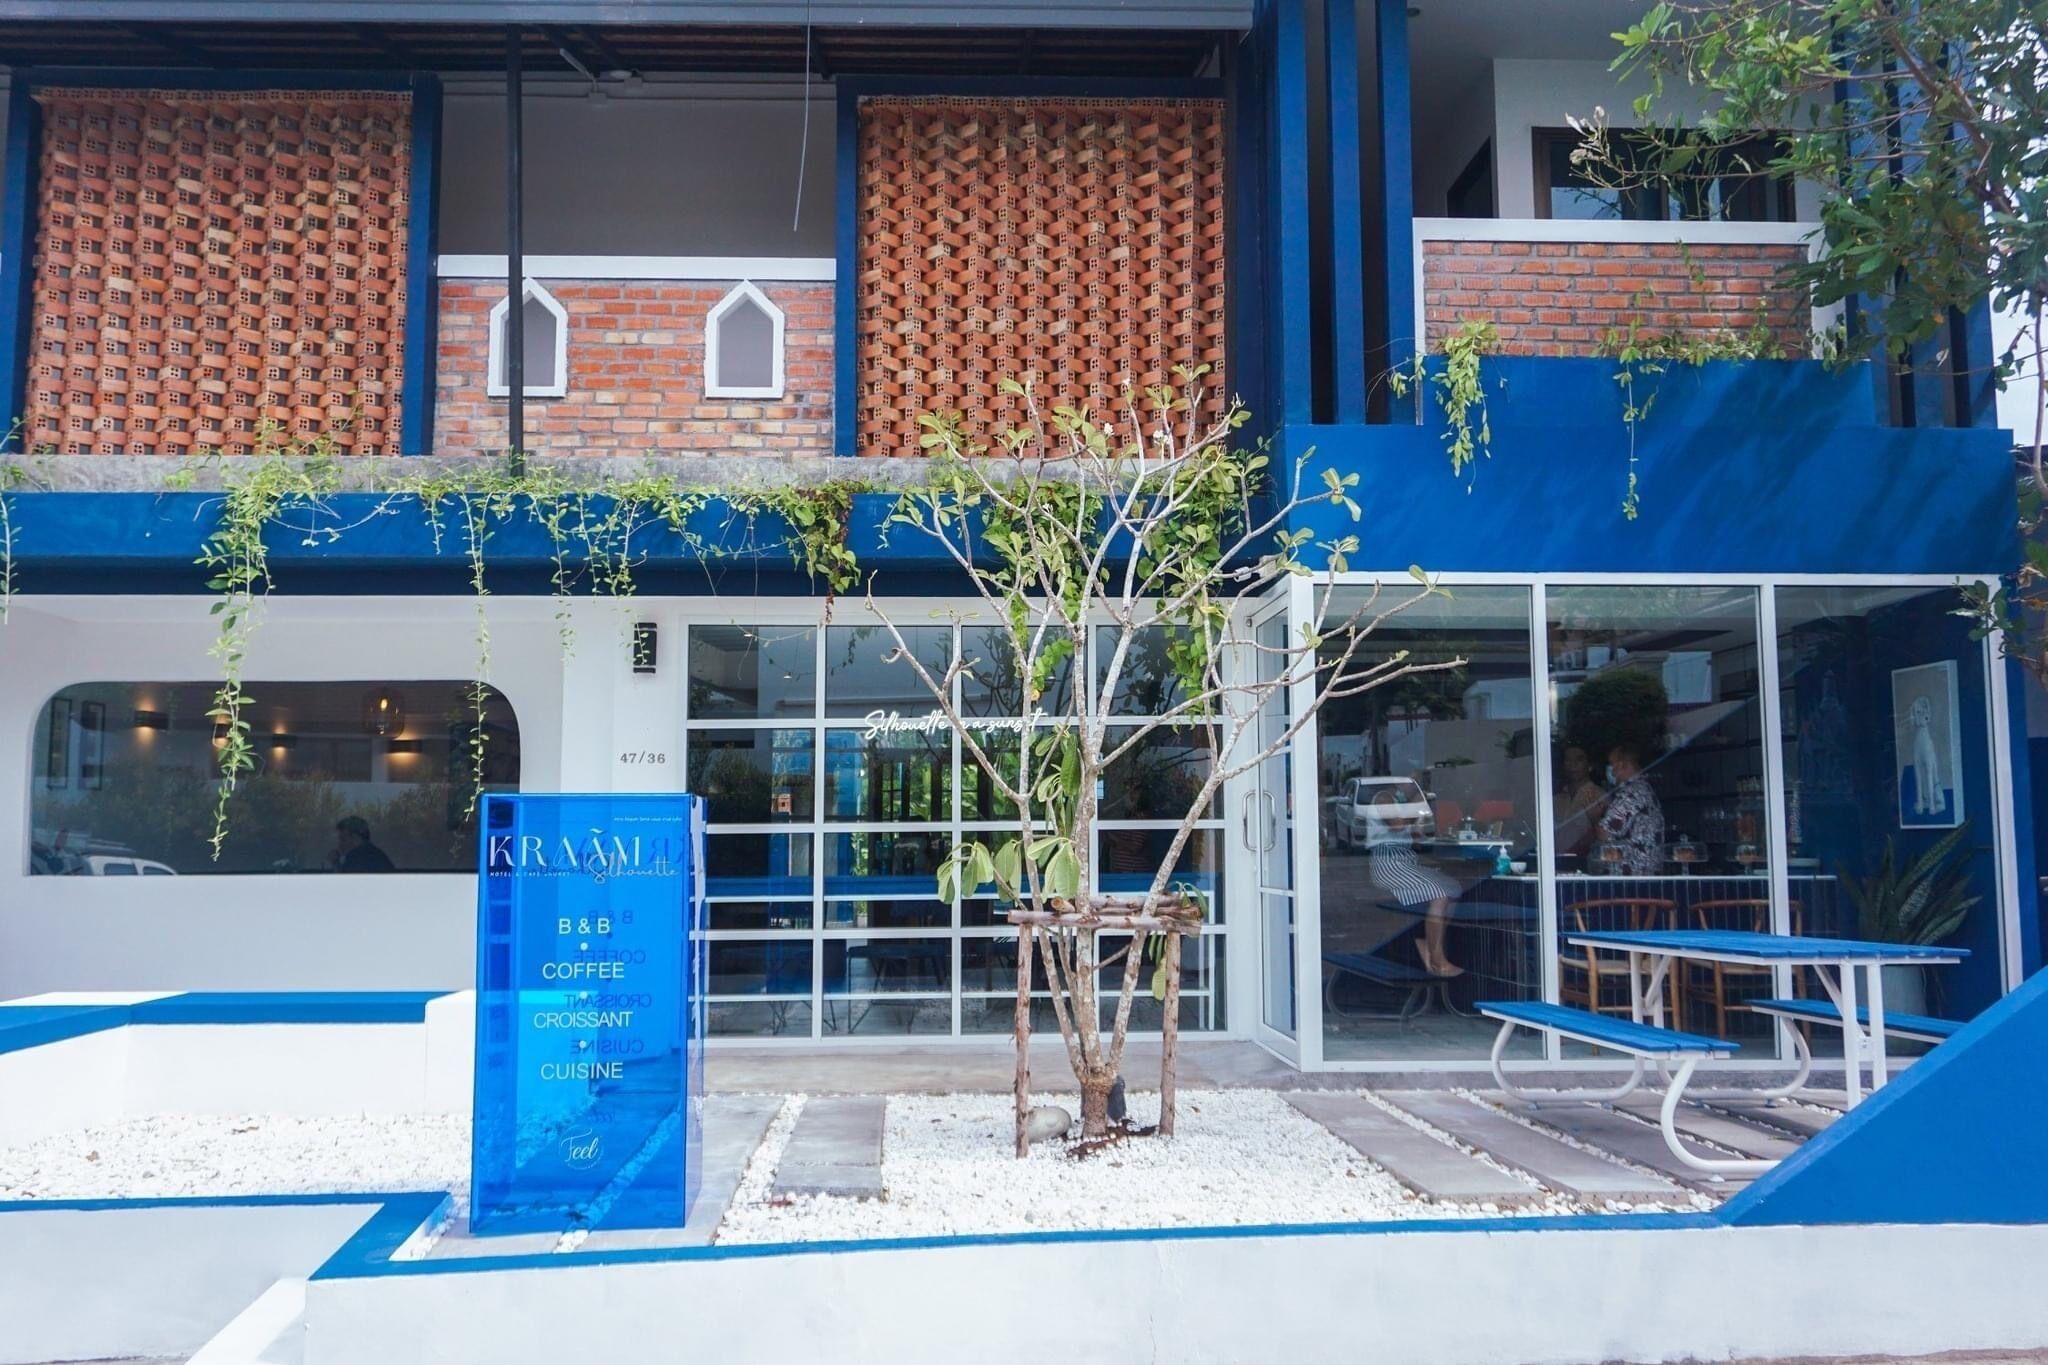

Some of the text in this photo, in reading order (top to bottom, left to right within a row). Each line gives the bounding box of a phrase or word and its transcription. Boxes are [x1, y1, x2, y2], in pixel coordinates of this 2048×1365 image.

[864, 710, 950, 740] Silhouette
[972, 719, 986, 730] a
[986, 707, 1048, 733] sunst
[620, 751, 666, 764] 47/36
[589, 851, 680, 884] Silhouette
[559, 918, 611, 934] B & B
[542, 962, 625, 979] COFFEE
[534, 1011, 633, 1029] CROISSANT
[540, 1062, 624, 1080] CUISINE
[560, 1128, 599, 1162] Feel
